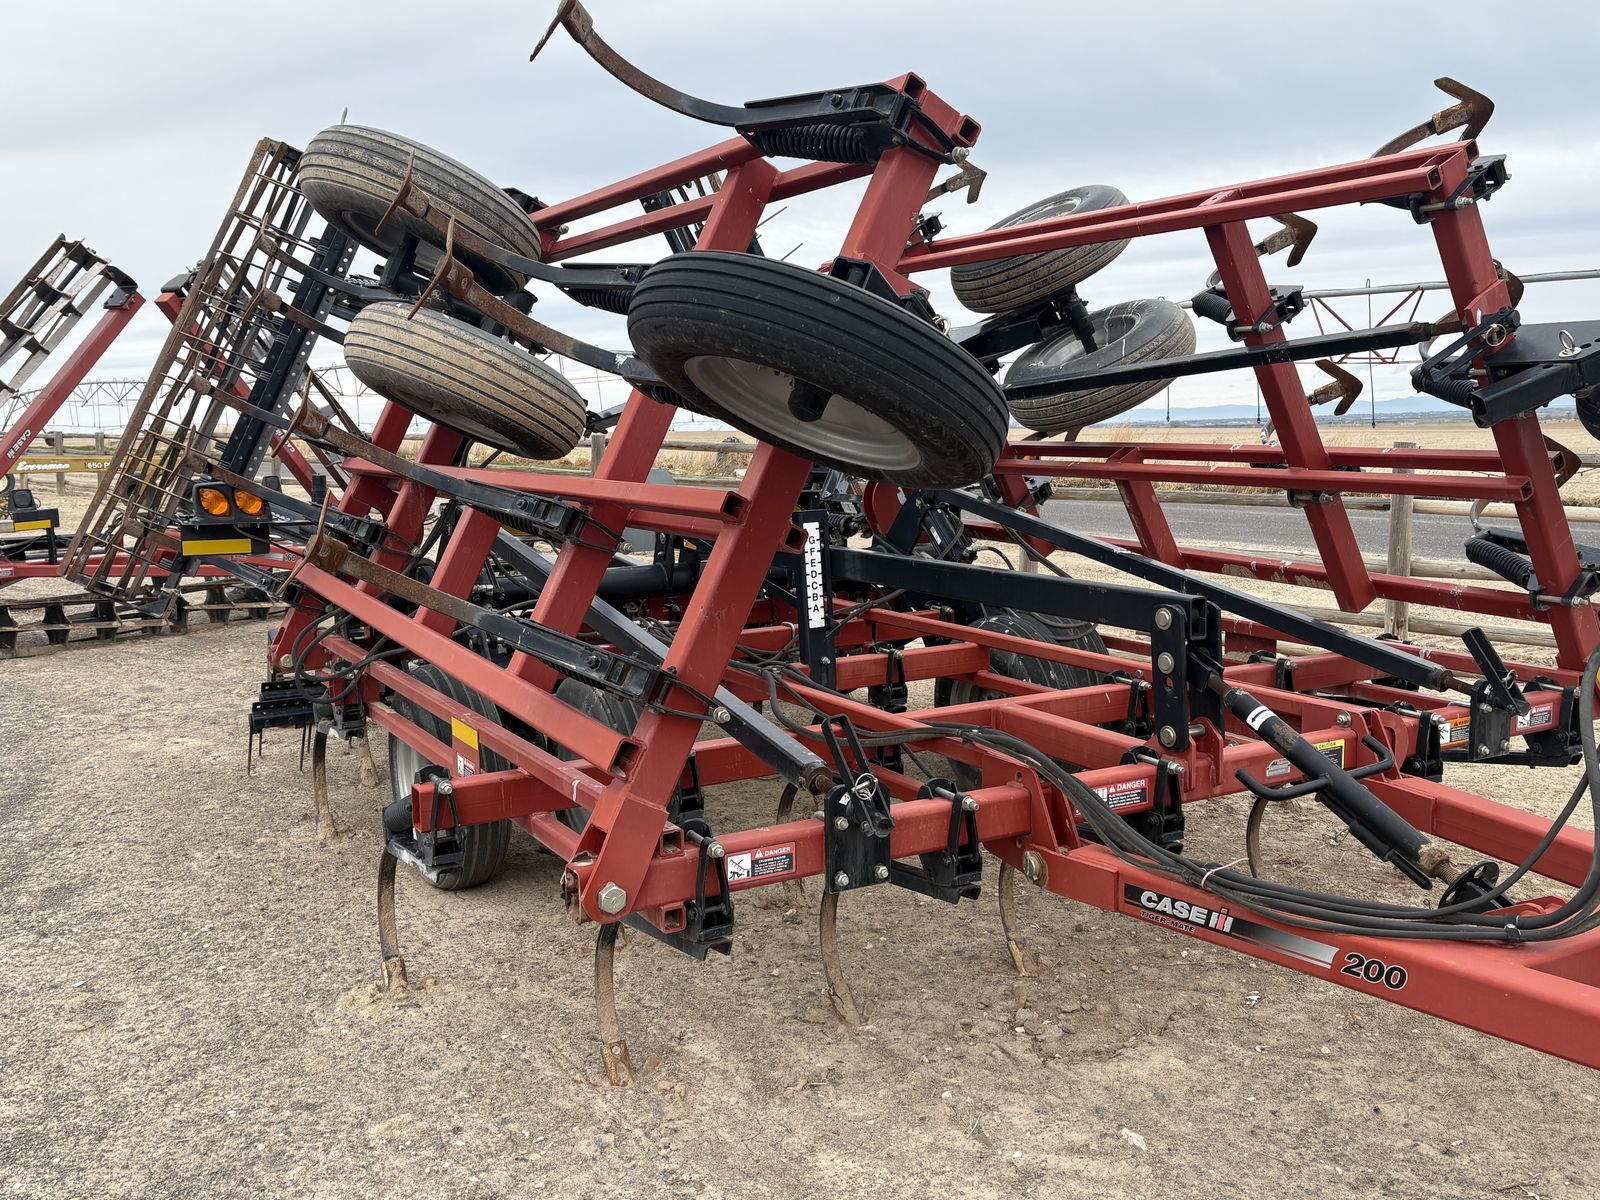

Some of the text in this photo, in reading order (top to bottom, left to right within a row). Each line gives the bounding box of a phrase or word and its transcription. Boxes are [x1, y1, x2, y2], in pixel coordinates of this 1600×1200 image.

[12, 429, 31, 452] CASE
[808, 535, 815, 545] G
[810, 547, 815, 556] F
[810, 558, 816, 568] E
[810, 570, 817, 579] D
[811, 581, 818, 590] C
[812, 592, 819, 601] B
[813, 604, 820, 613] A
[1318, 741, 1337, 749] CAUTION
[1117, 779, 1145, 791] DANGER
[764, 846, 791, 857] DANGER
[1141, 891, 1209, 926] CASE
[1140, 910, 1196, 933] TIGER-MATE
[1340, 951, 1408, 991] 200
